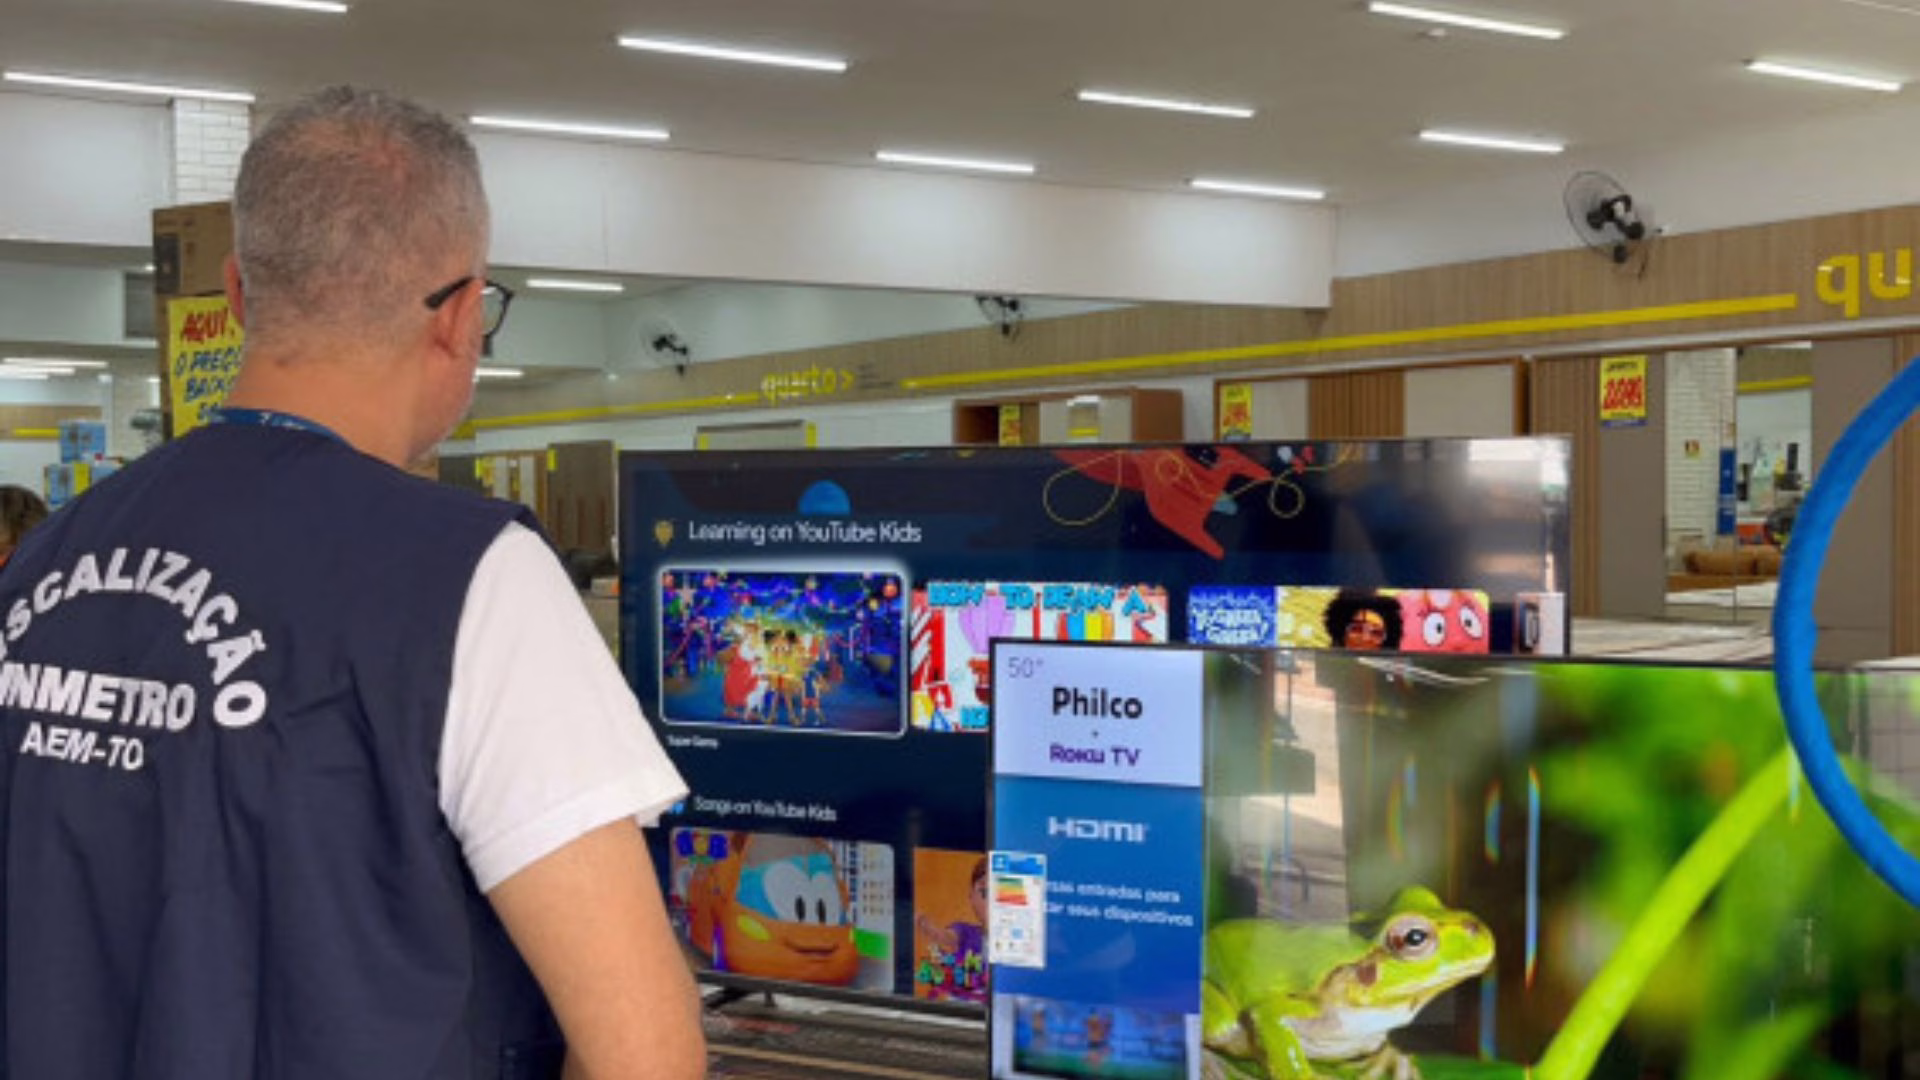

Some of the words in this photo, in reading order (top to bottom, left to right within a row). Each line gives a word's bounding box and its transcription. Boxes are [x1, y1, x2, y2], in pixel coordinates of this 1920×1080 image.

[689, 520, 766, 546] Learning
[768, 525, 793, 542] on
[796, 520, 877, 543] YouTube
[879, 521, 923, 543] Kids
[999, 584, 1035, 610] TO
[1052, 686, 1143, 719] Philco
[20, 721, 144, 771] AEM-TO
[1110, 745, 1142, 767] TV
[694, 796, 730, 816] Songs
[752, 800, 806, 819] YouTube
[808, 803, 837, 822] Kids
[1048, 816, 1147, 844] HDMI
[1077, 883, 1142, 899] entradas
[1103, 904, 1195, 927] dispositivos
